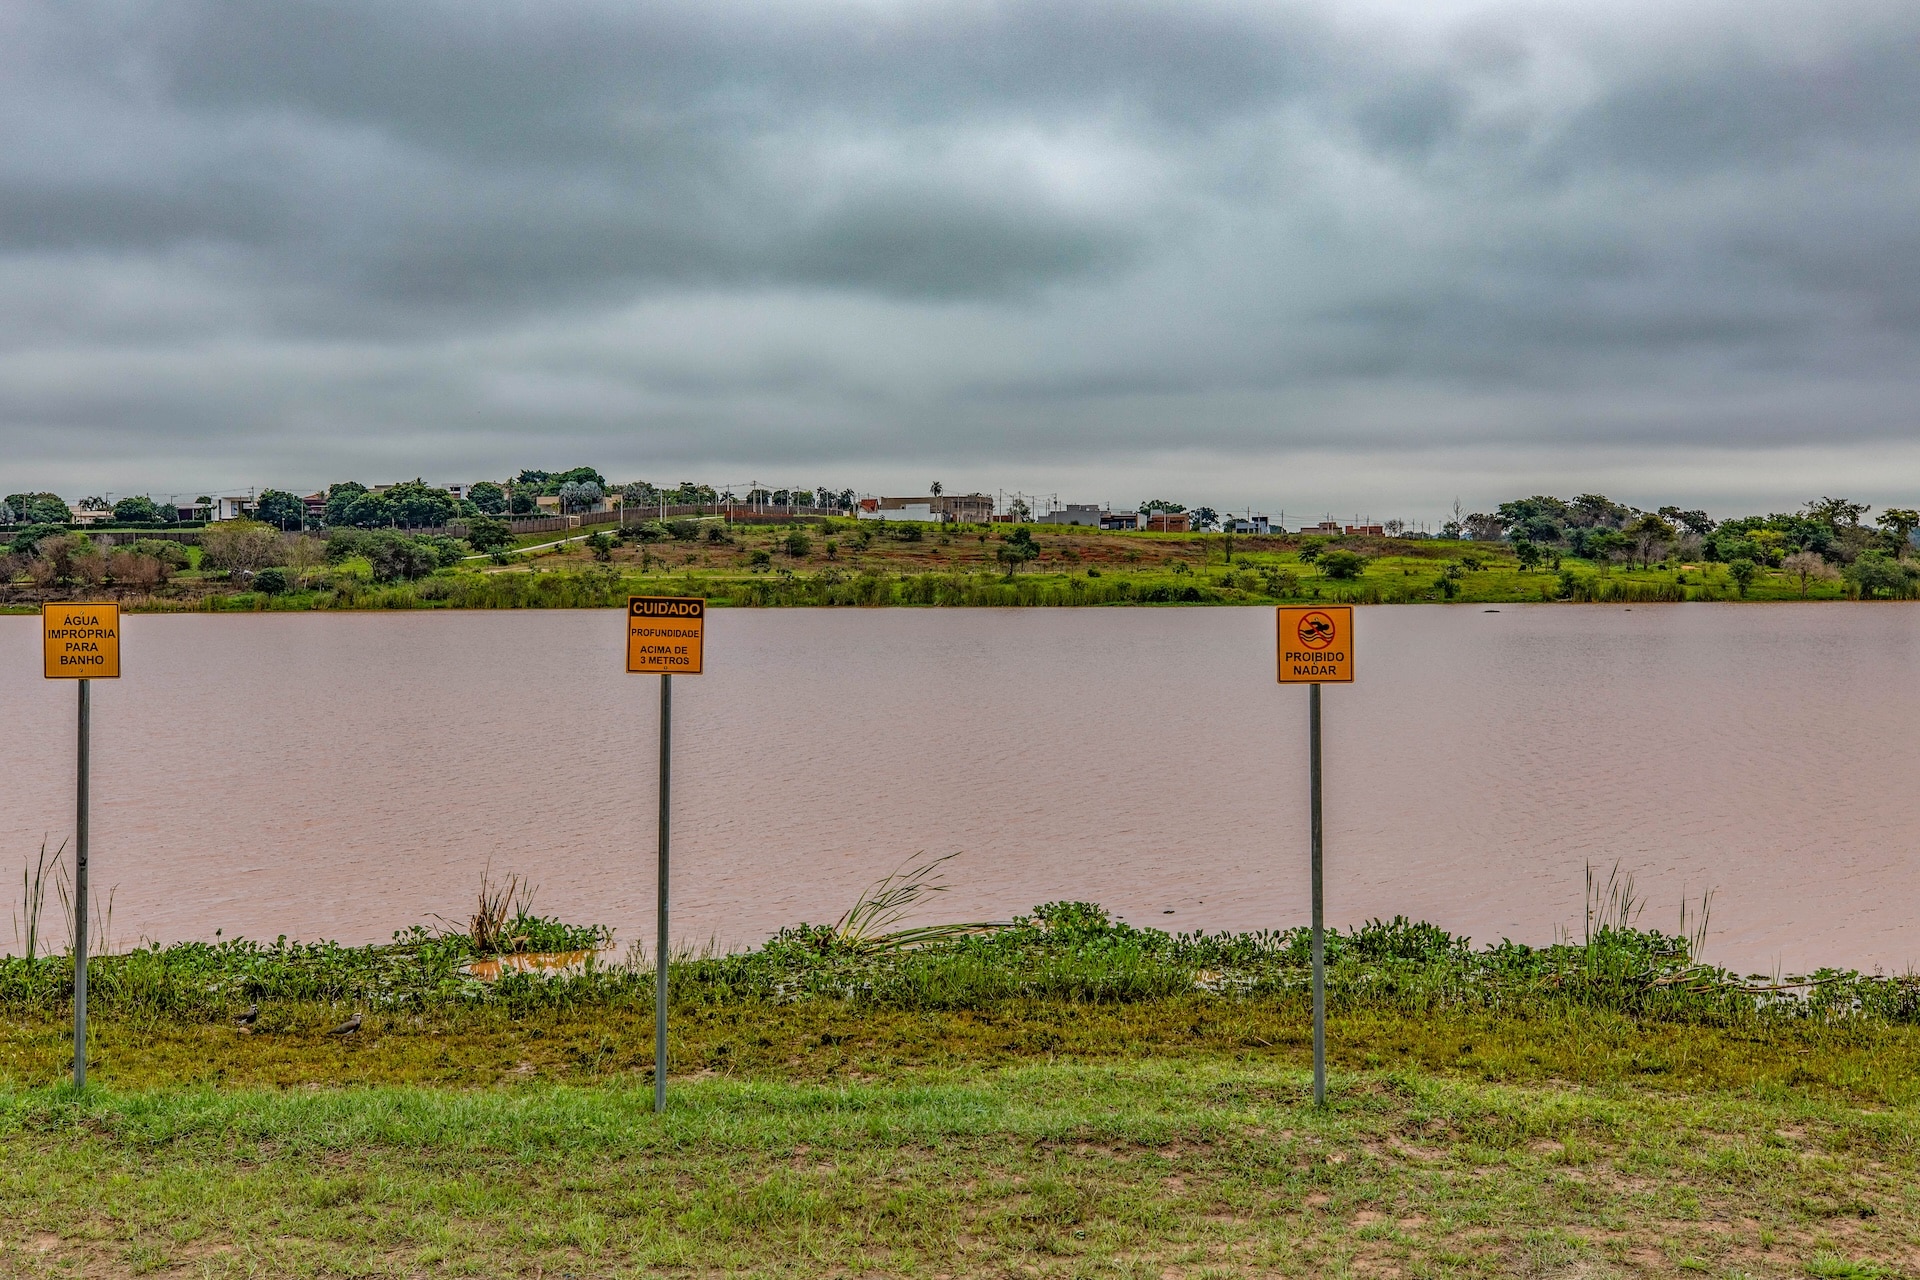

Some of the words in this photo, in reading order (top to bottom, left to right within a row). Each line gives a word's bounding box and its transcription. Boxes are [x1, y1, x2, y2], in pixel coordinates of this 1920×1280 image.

[633, 601, 700, 615] CUIDADO
[63, 613, 99, 626] ÁGUA
[48, 627, 116, 639] IMPRÓPRIA
[631, 628, 699, 638] PROFUNDIDADE
[65, 642, 98, 652] PARA
[640, 645, 672, 654] ACIMA
[674, 646, 688, 654] DE
[60, 655, 104, 665] BANHO
[640, 656, 646, 664] 3
[648, 656, 690, 665] METROS
[1285, 652, 1344, 662] PROIBIDO
[1293, 665, 1336, 675] NADAR
